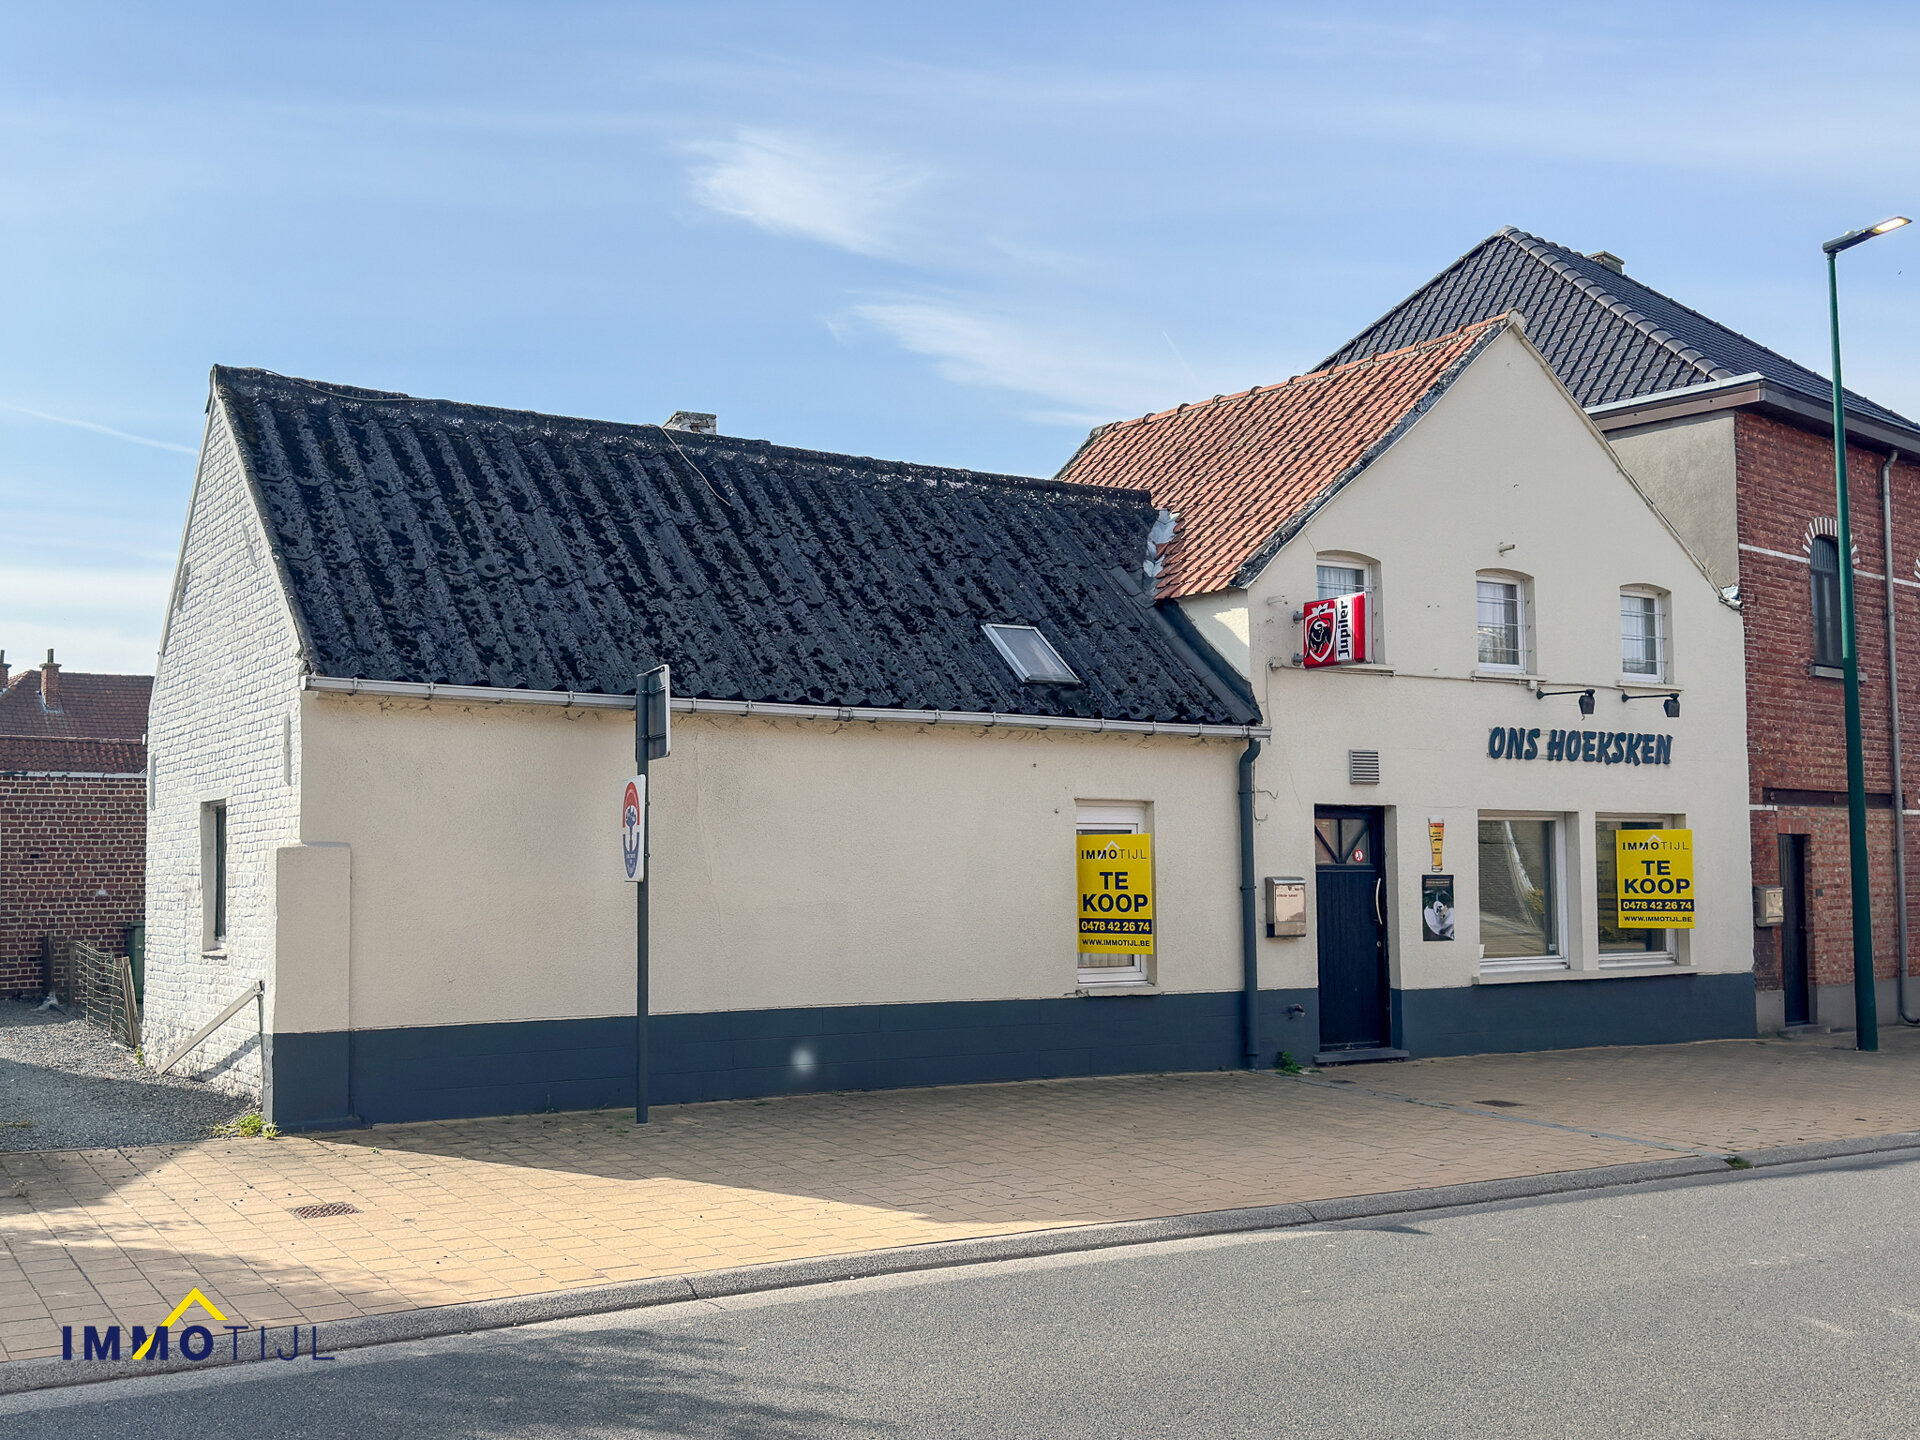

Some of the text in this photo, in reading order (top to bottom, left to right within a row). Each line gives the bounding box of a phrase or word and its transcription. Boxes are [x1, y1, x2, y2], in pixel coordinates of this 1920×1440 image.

[1338, 600, 1351, 658] Jupiler
[1488, 727, 1673, 766] ONS HOEKSKEN
[1622, 841, 1689, 851] IMMOTIJL
[1081, 848, 1147, 860] IMMOTIJL
[1641, 860, 1671, 876] TE
[1099, 871, 1129, 890] TE
[1624, 878, 1691, 894] KOOP
[1082, 893, 1149, 912] KOOP
[1623, 901, 1692, 910] 0478 42 26 74
[1623, 915, 1693, 923] WWW.IMMOTIJL.BE
[1081, 921, 1150, 932] 0478 42 26 74
[1081, 938, 1150, 947] WWW.IMMOTIJL.BE
